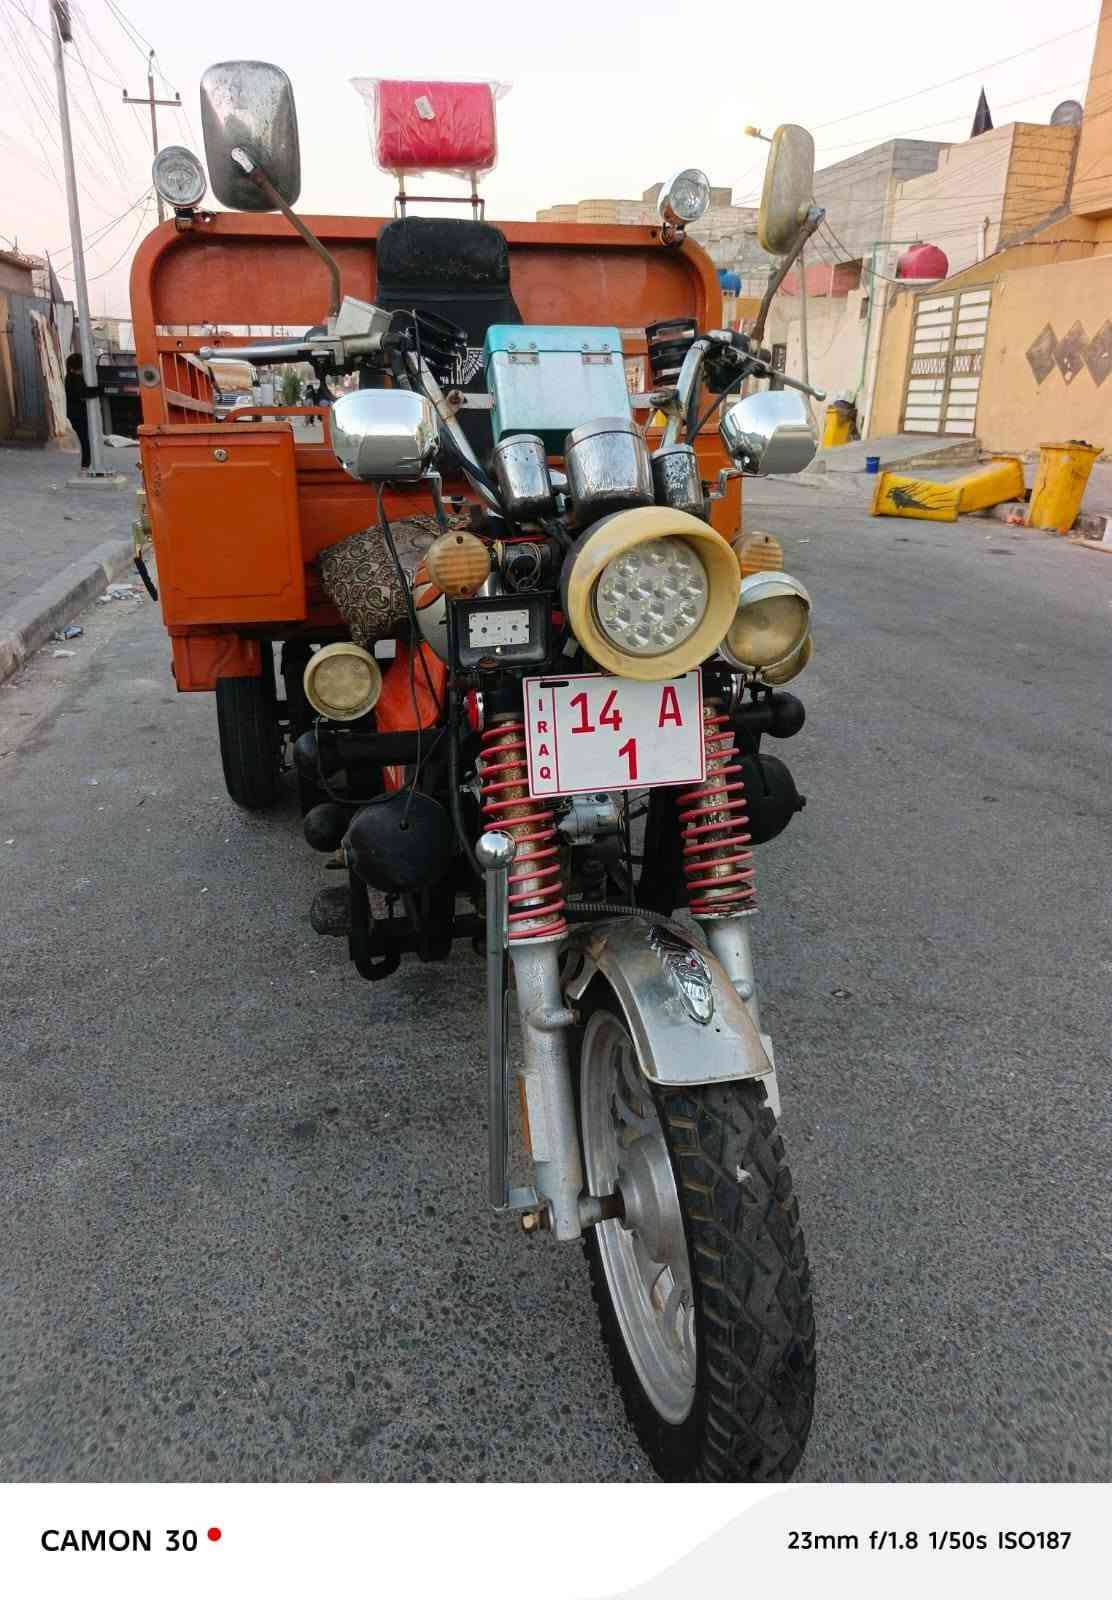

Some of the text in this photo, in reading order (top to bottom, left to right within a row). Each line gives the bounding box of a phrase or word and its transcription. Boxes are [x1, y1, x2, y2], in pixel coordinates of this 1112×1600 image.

[569, 686, 683, 734] 14 A
[536, 698, 552, 780] IRAQ
[618, 738, 639, 781] 1
